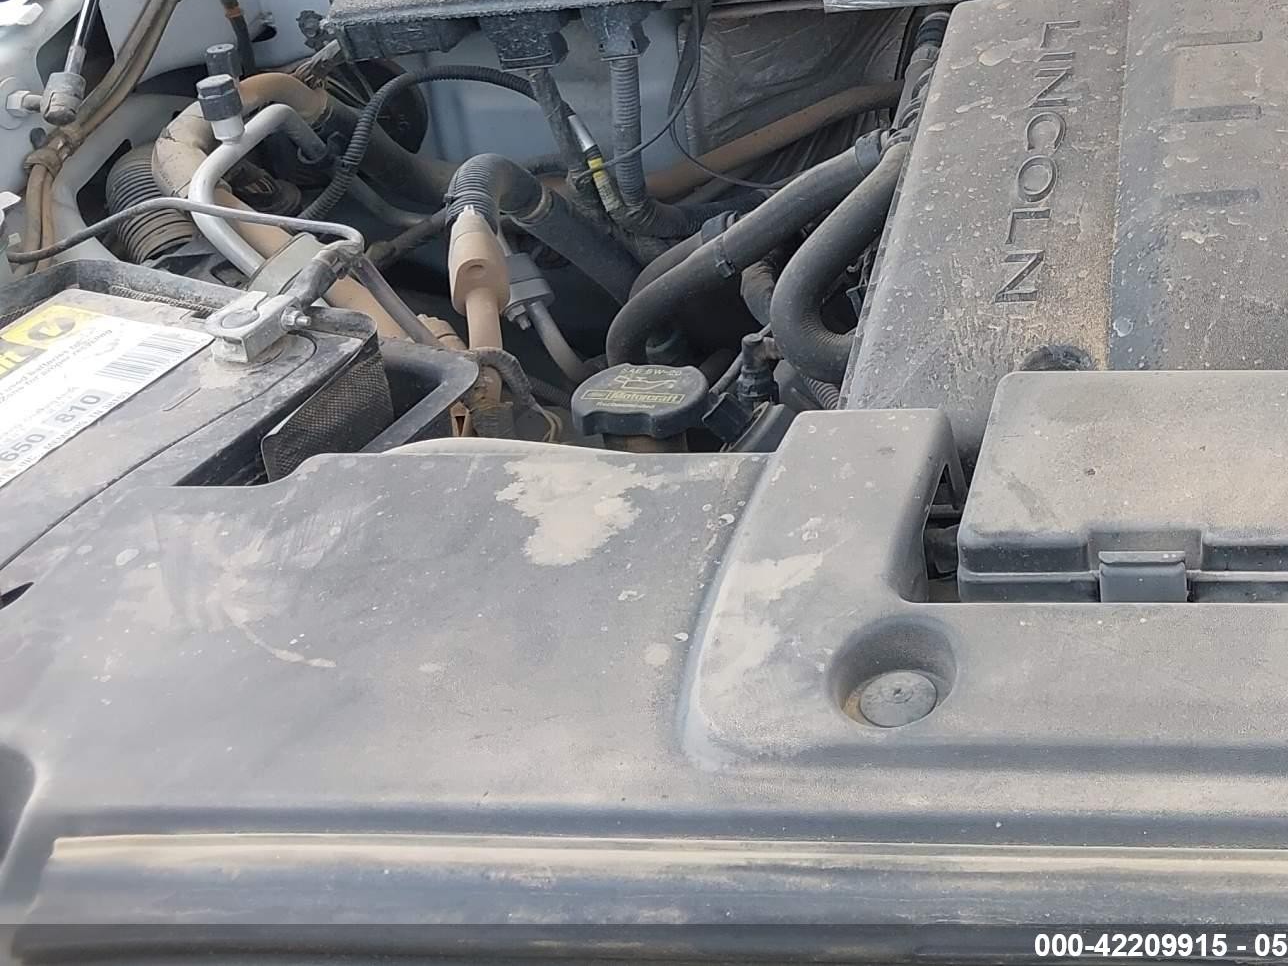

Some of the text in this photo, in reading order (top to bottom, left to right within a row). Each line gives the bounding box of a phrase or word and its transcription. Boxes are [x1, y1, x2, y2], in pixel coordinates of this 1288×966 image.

[993, 20, 1081, 305] LINCOLN
[621, 367, 642, 376] SAE
[0, 433, 46, 463] 650
[54, 393, 102, 424] 810
